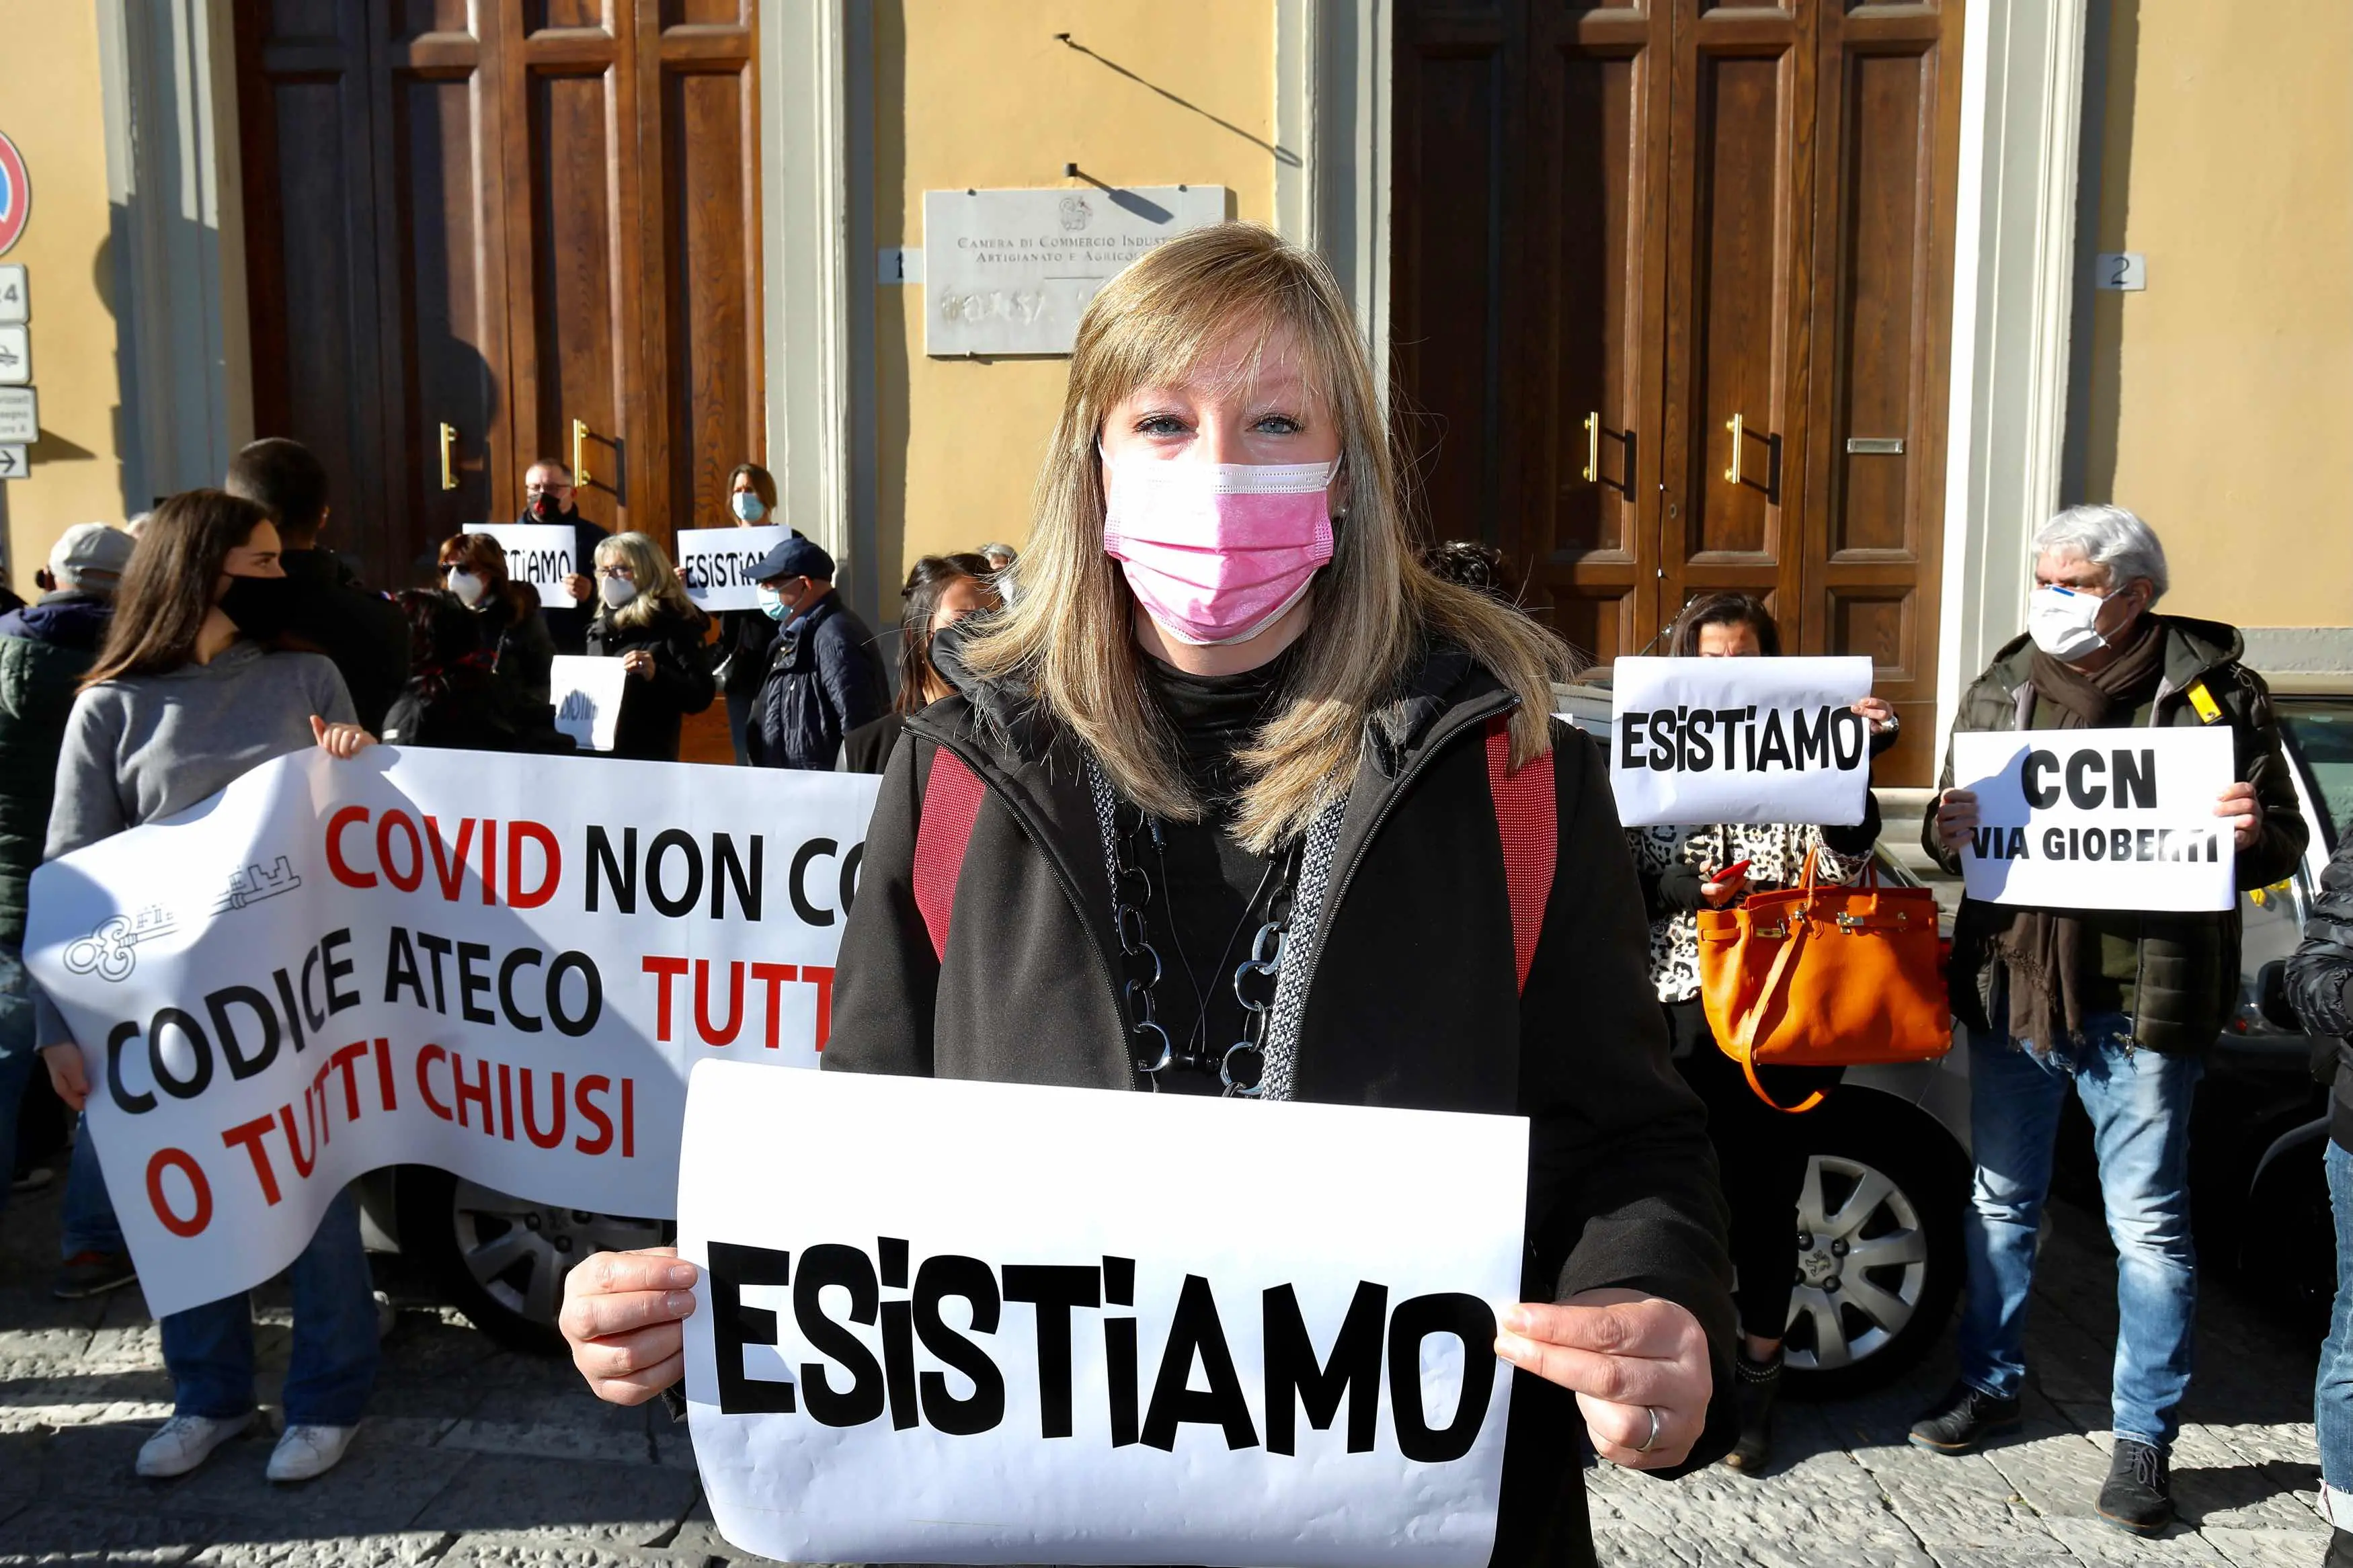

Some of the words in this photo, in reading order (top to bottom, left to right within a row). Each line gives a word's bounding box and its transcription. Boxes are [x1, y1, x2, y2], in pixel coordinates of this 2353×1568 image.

[895, 250, 904, 279] 1
[2111, 256, 2130, 285] 2
[0, 283, 19, 304] 4
[2021, 749, 2157, 810] CCN
[325, 805, 562, 909] COVID
[585, 825, 764, 923] NON
[1971, 827, 2030, 860] VIA
[107, 927, 361, 1114] CODICE
[384, 926, 603, 1038] ATECO
[145, 1147, 212, 1238] O
[222, 1037, 398, 1206] TUTTI
[416, 1043, 635, 1159] CHIUSI
